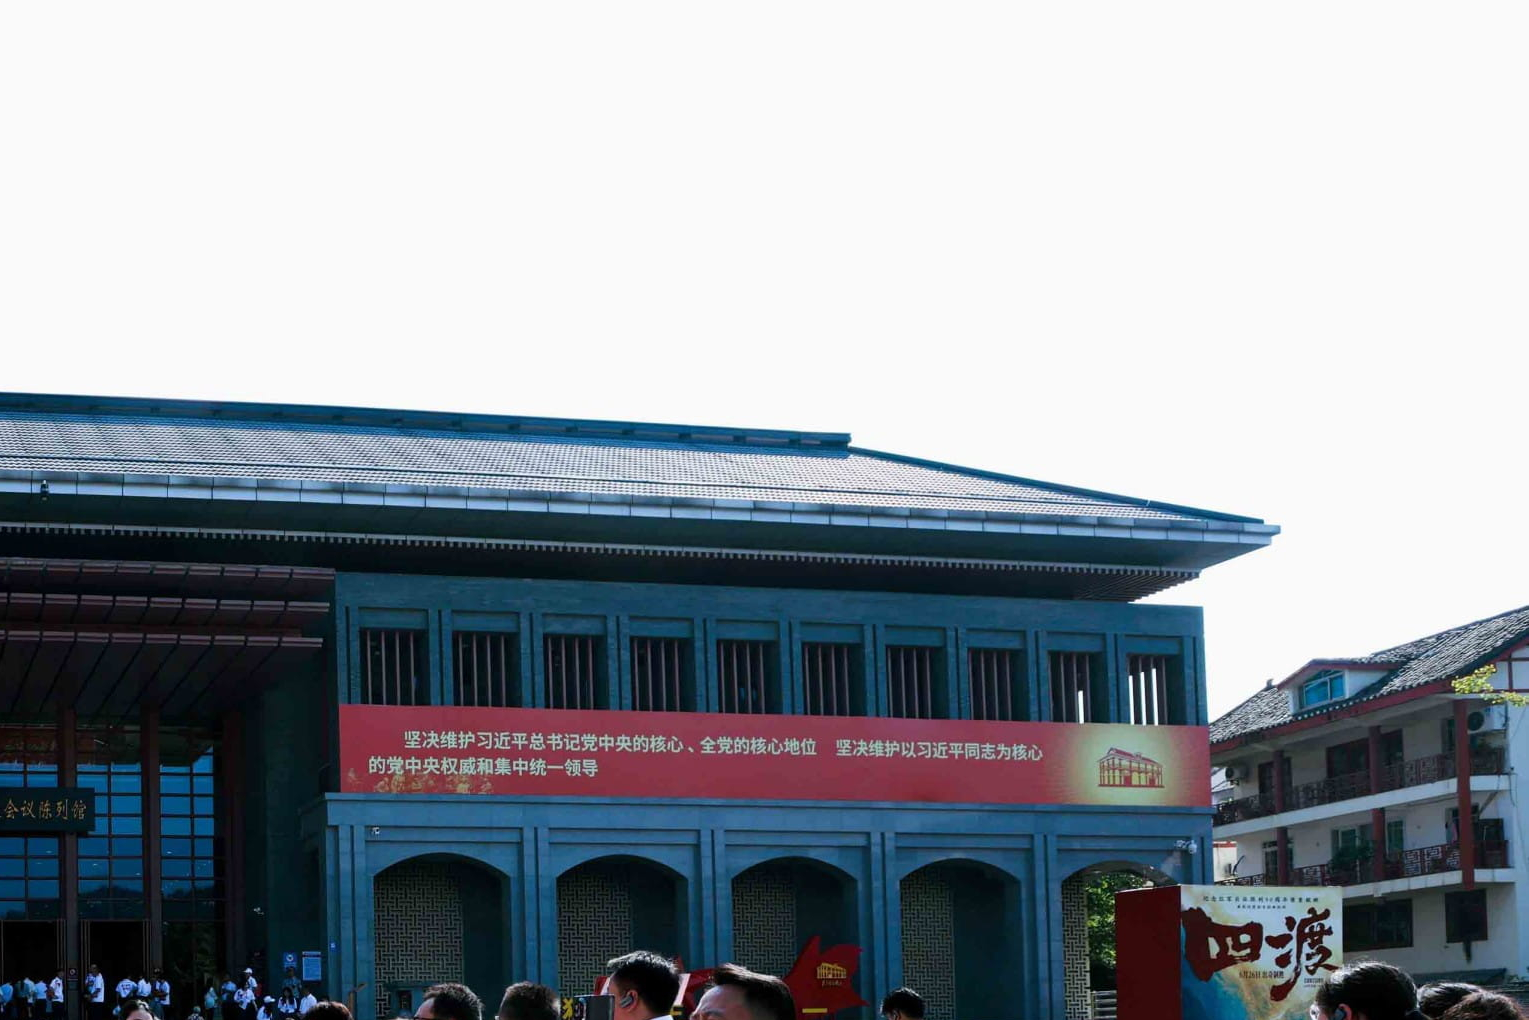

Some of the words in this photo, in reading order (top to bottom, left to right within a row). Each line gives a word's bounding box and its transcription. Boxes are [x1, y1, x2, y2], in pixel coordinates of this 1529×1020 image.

[404, 730, 817, 757] 坚决维护习近平总书记党中央的核心、全党的核心地位
[836, 739, 1043, 761] 坚决维护以习近平同志为核心
[368, 755, 598, 778] 的党中央权威和集中统一领导
[1181, 907, 1339, 1001] 四渡
